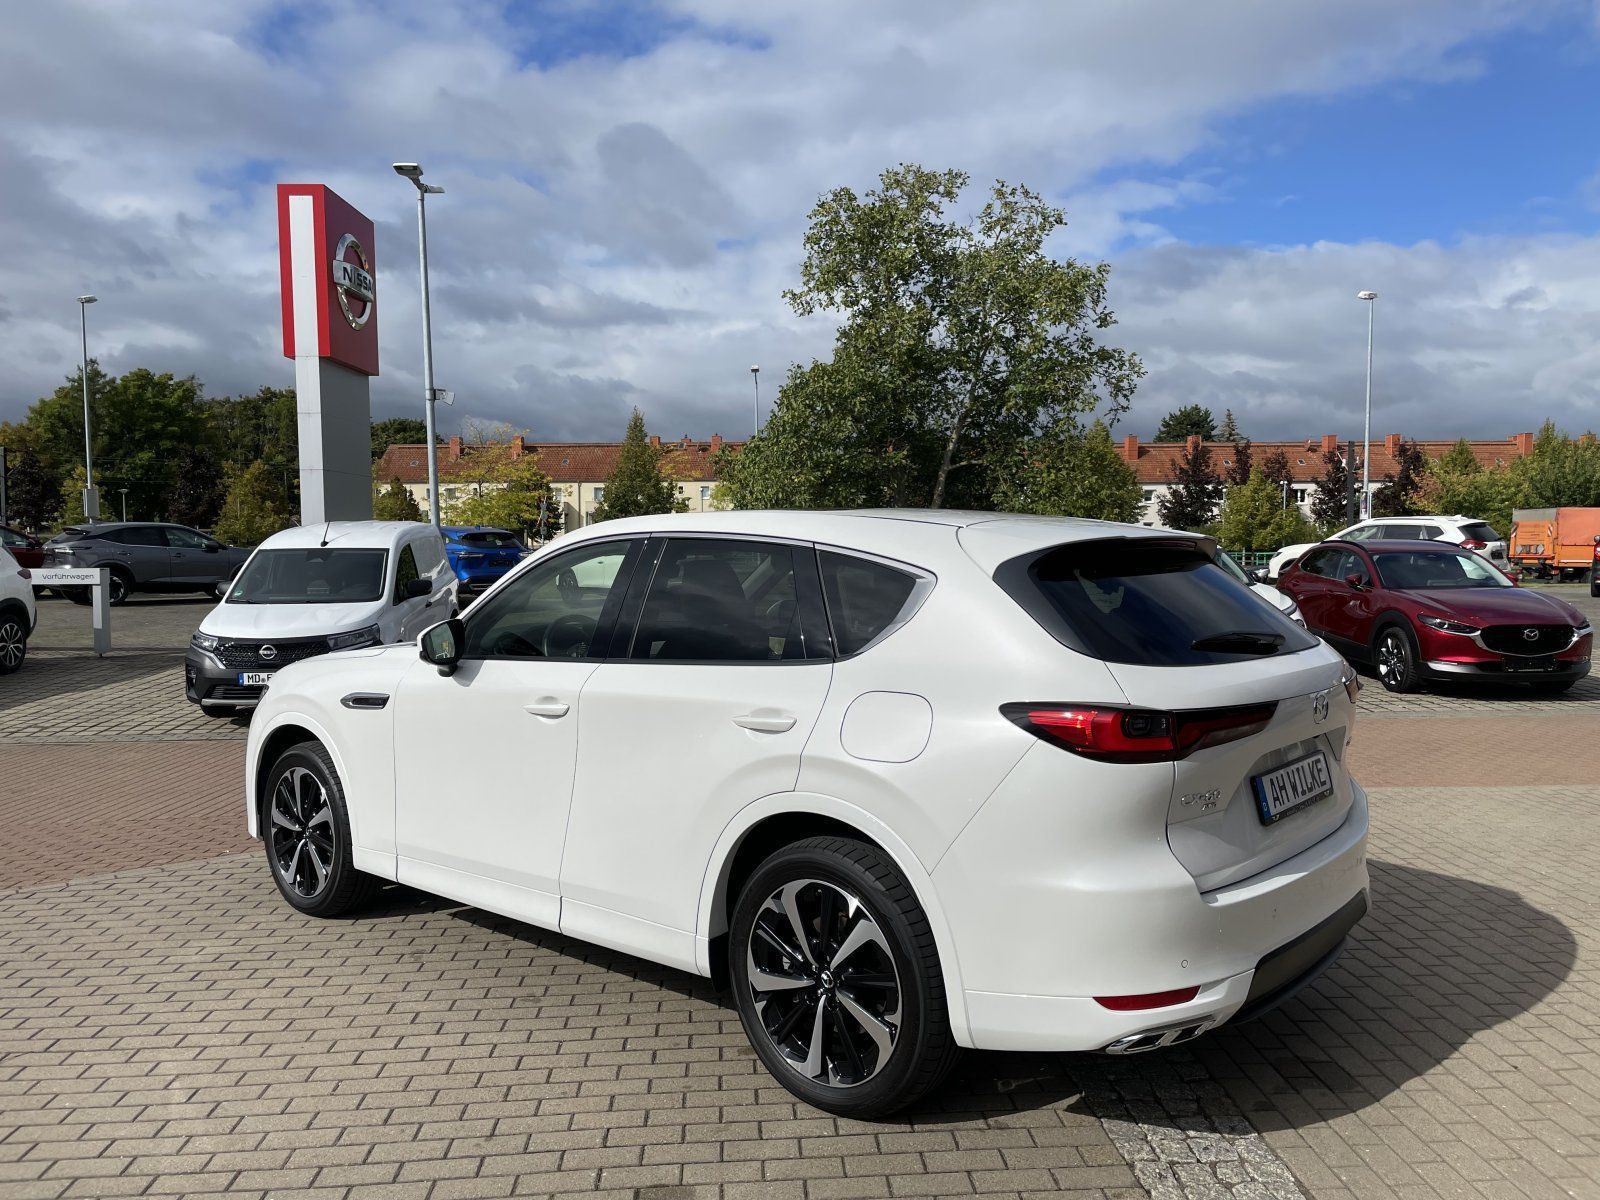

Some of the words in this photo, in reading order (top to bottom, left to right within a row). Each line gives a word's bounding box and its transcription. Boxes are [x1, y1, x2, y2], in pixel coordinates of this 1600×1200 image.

[343, 266, 373, 293] NISSA
[247, 674, 261, 684] MD
[1269, 773, 1290, 809] AH
[1286, 757, 1327, 800] WILKE
